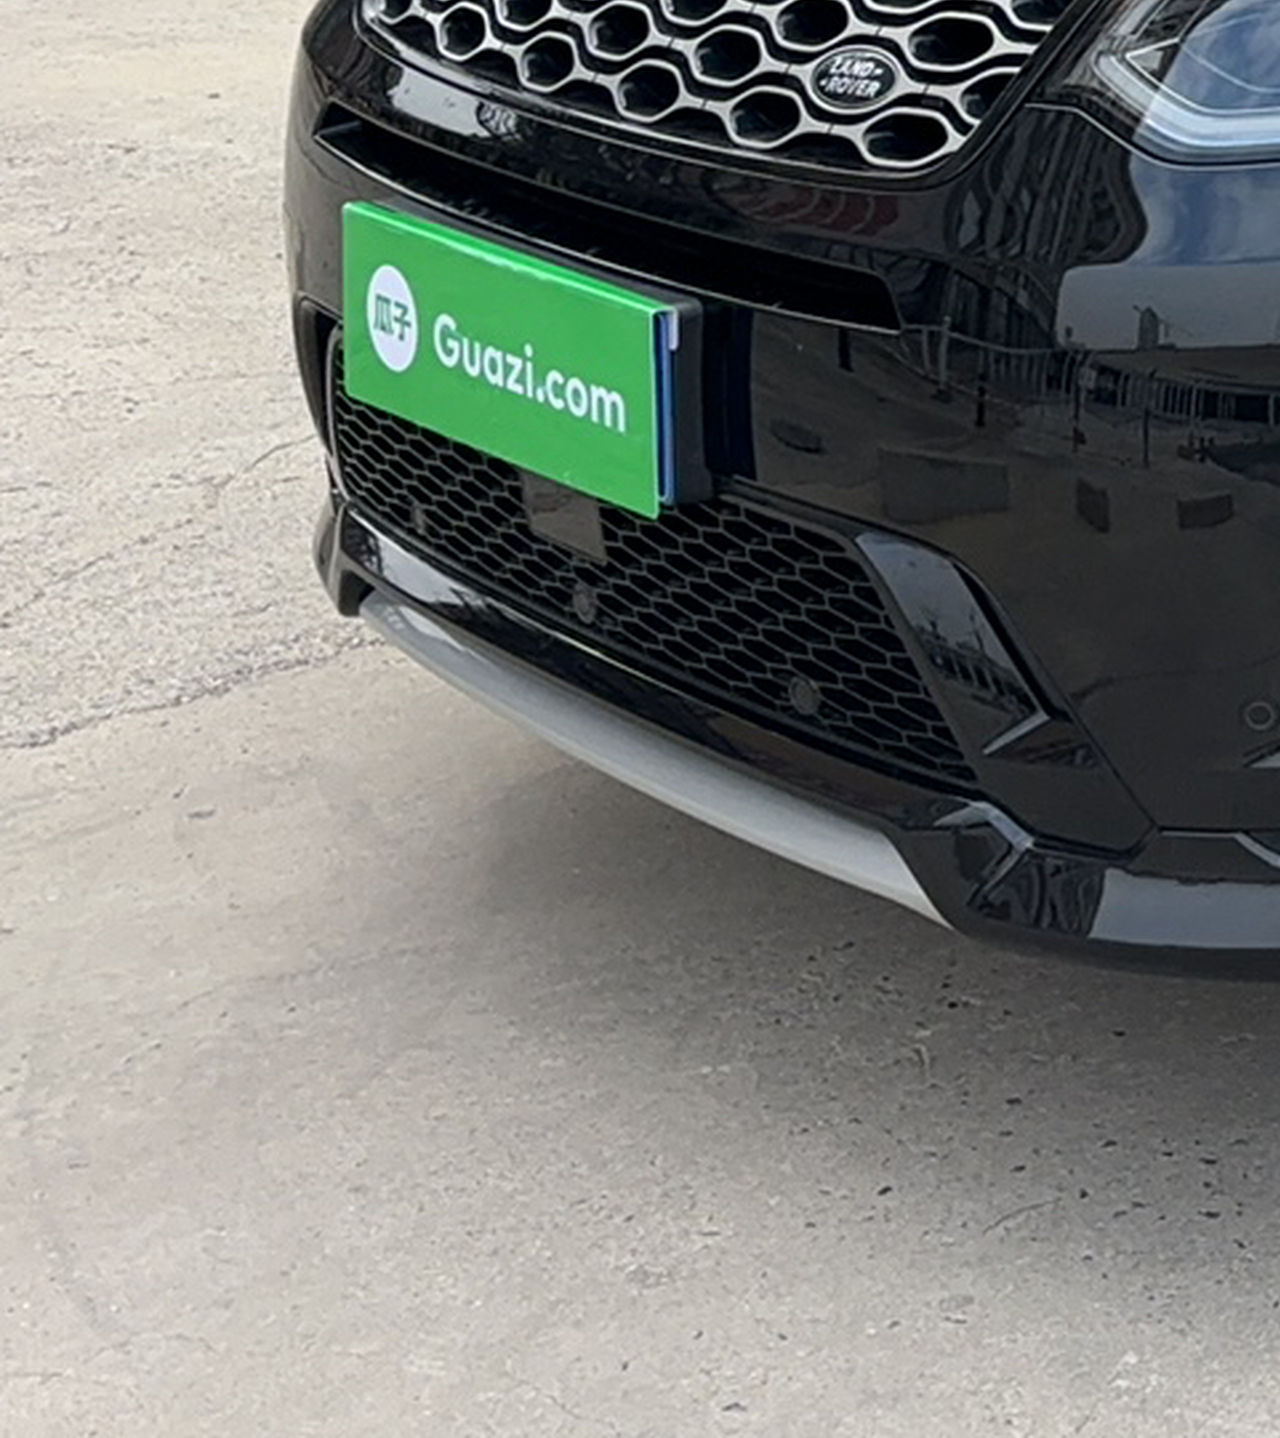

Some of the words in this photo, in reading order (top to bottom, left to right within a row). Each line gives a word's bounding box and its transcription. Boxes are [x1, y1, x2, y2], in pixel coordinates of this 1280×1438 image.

[829, 55, 876, 78] LAND
[824, 76, 881, 98] ROVER
[372, 293, 412, 342] 瓜子
[432, 312, 627, 434] Guazi.com
